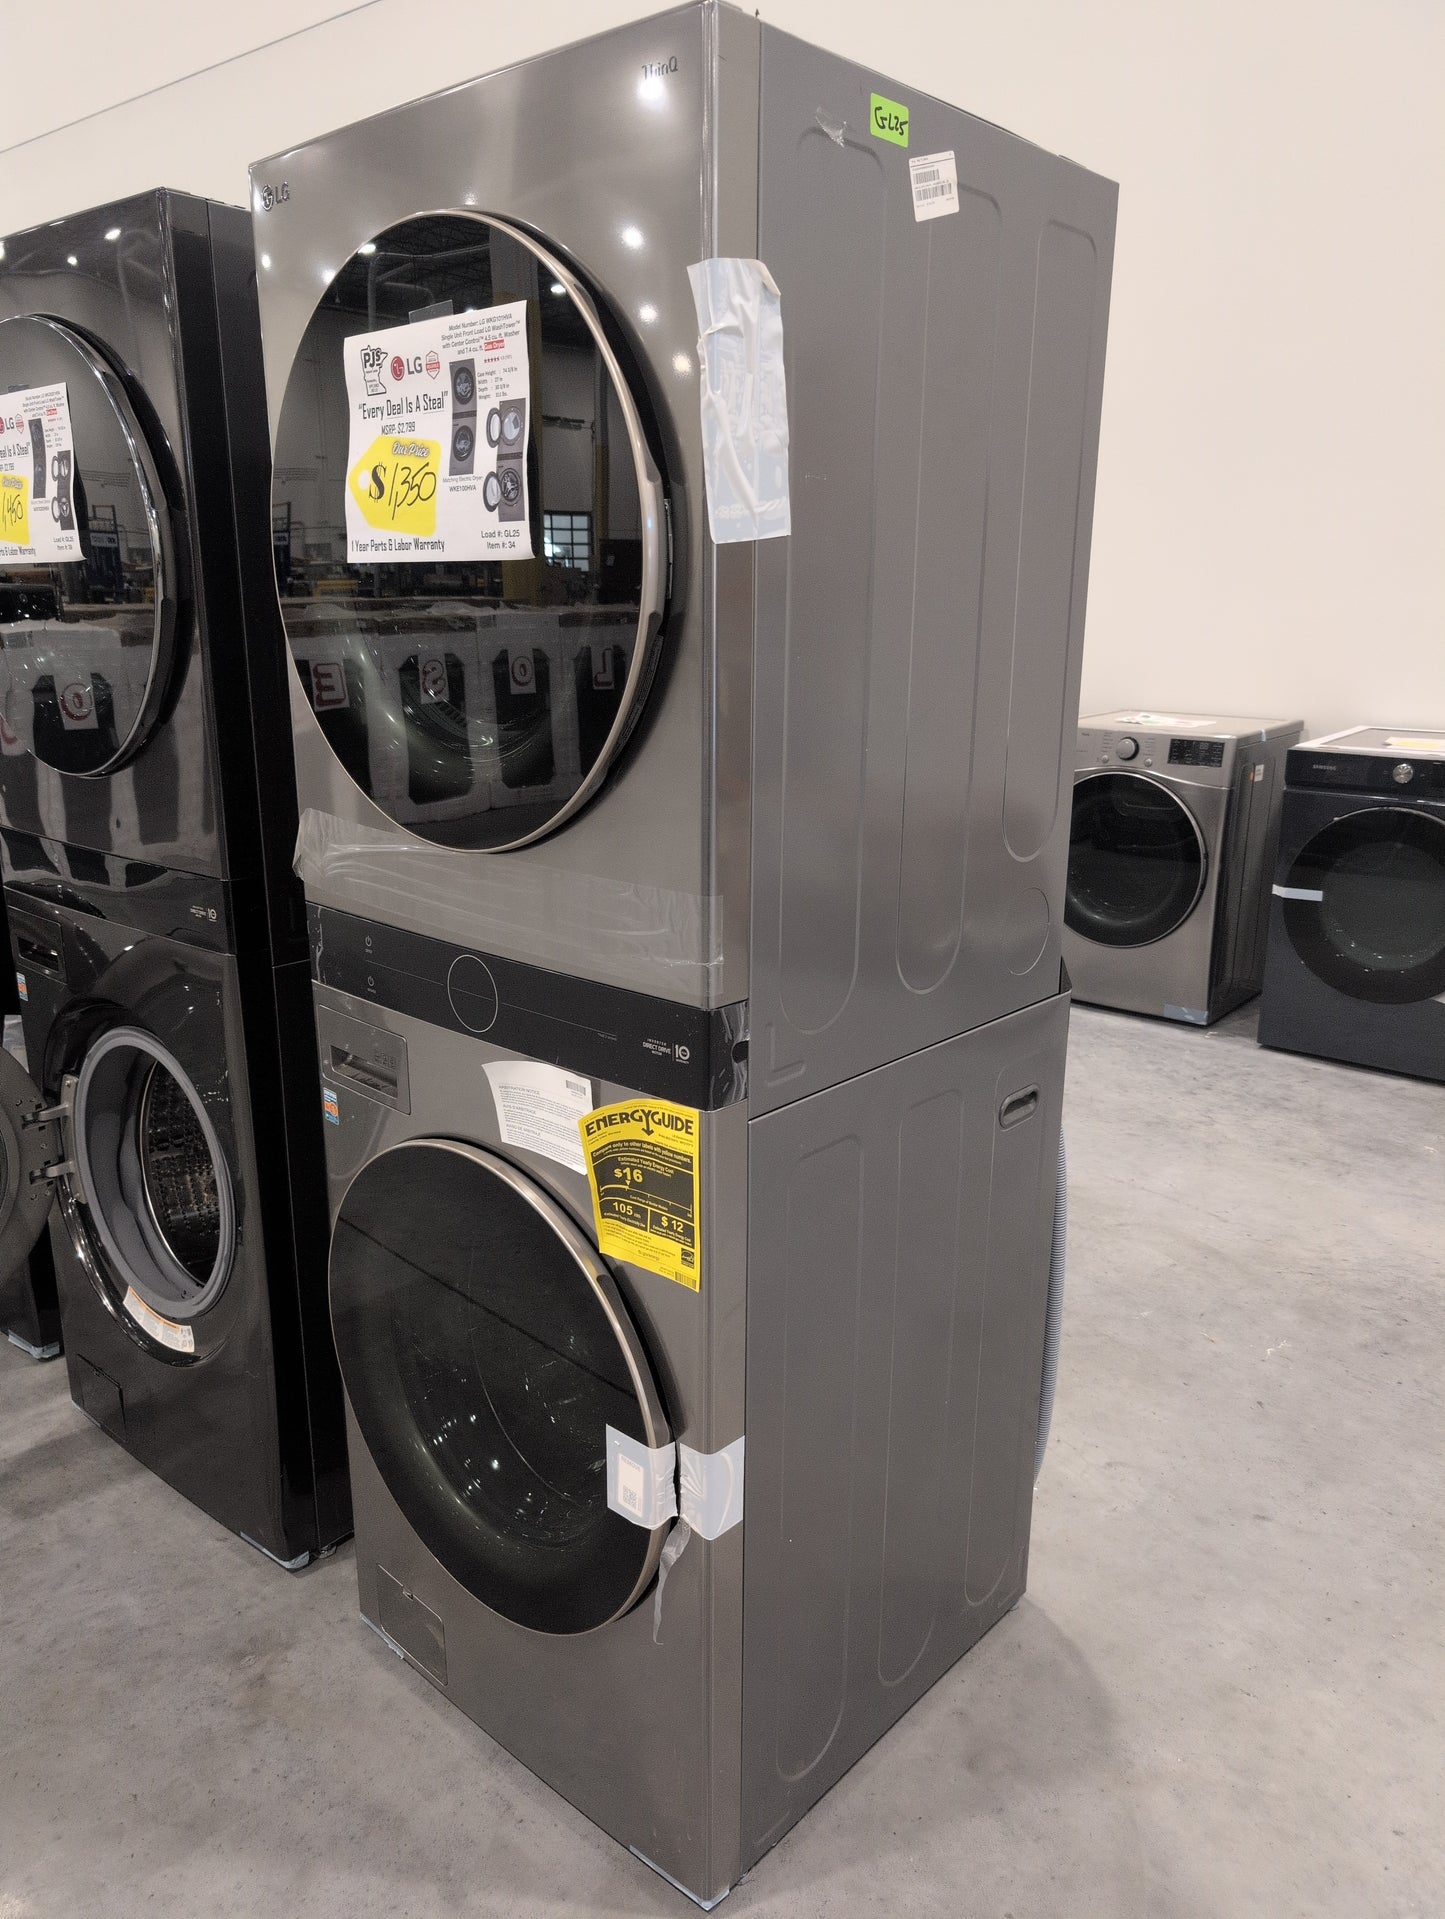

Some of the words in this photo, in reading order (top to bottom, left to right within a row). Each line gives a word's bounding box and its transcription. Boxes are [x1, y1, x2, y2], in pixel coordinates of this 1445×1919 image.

[874, 106, 909, 135] GL25
[407, 356, 423, 375] LG
[386, 397, 403, 416] Deal
[405, 396, 413, 414] Is
[415, 394, 421, 412] A
[5, 417, 15, 430] LG
[392, 441, 409, 455] Our
[409, 443, 430, 457] Price
[481, 531, 496, 539] Load
[355, 540, 369, 552] Year
[370, 539, 388, 551] Parts
[388, 539, 393, 551] &
[394, 538, 412, 551] Labor
[413, 538, 445, 552] Warranty
[487, 541, 501, 549] Item
[508, 541, 516, 549] 34
[643, 1041, 658, 1050] DIRECT
[658, 1046, 671, 1054] DRIVE
[675, 1044, 690, 1060] 10
[592, 1145, 612, 1157] Compare
[642, 1142, 653, 1150] labels
[654, 1145, 662, 1154] with
[662, 1147, 673, 1158] yellow
[674, 1151, 692, 1163] numbers.
[640, 1159, 652, 1167] Yearly
[652, 1162, 664, 1171] Energy
[614, 1167, 643, 1183] $16
[613, 1202, 633, 1216] 105
[661, 1216, 669, 1228] $
[671, 1219, 684, 1232] 12
